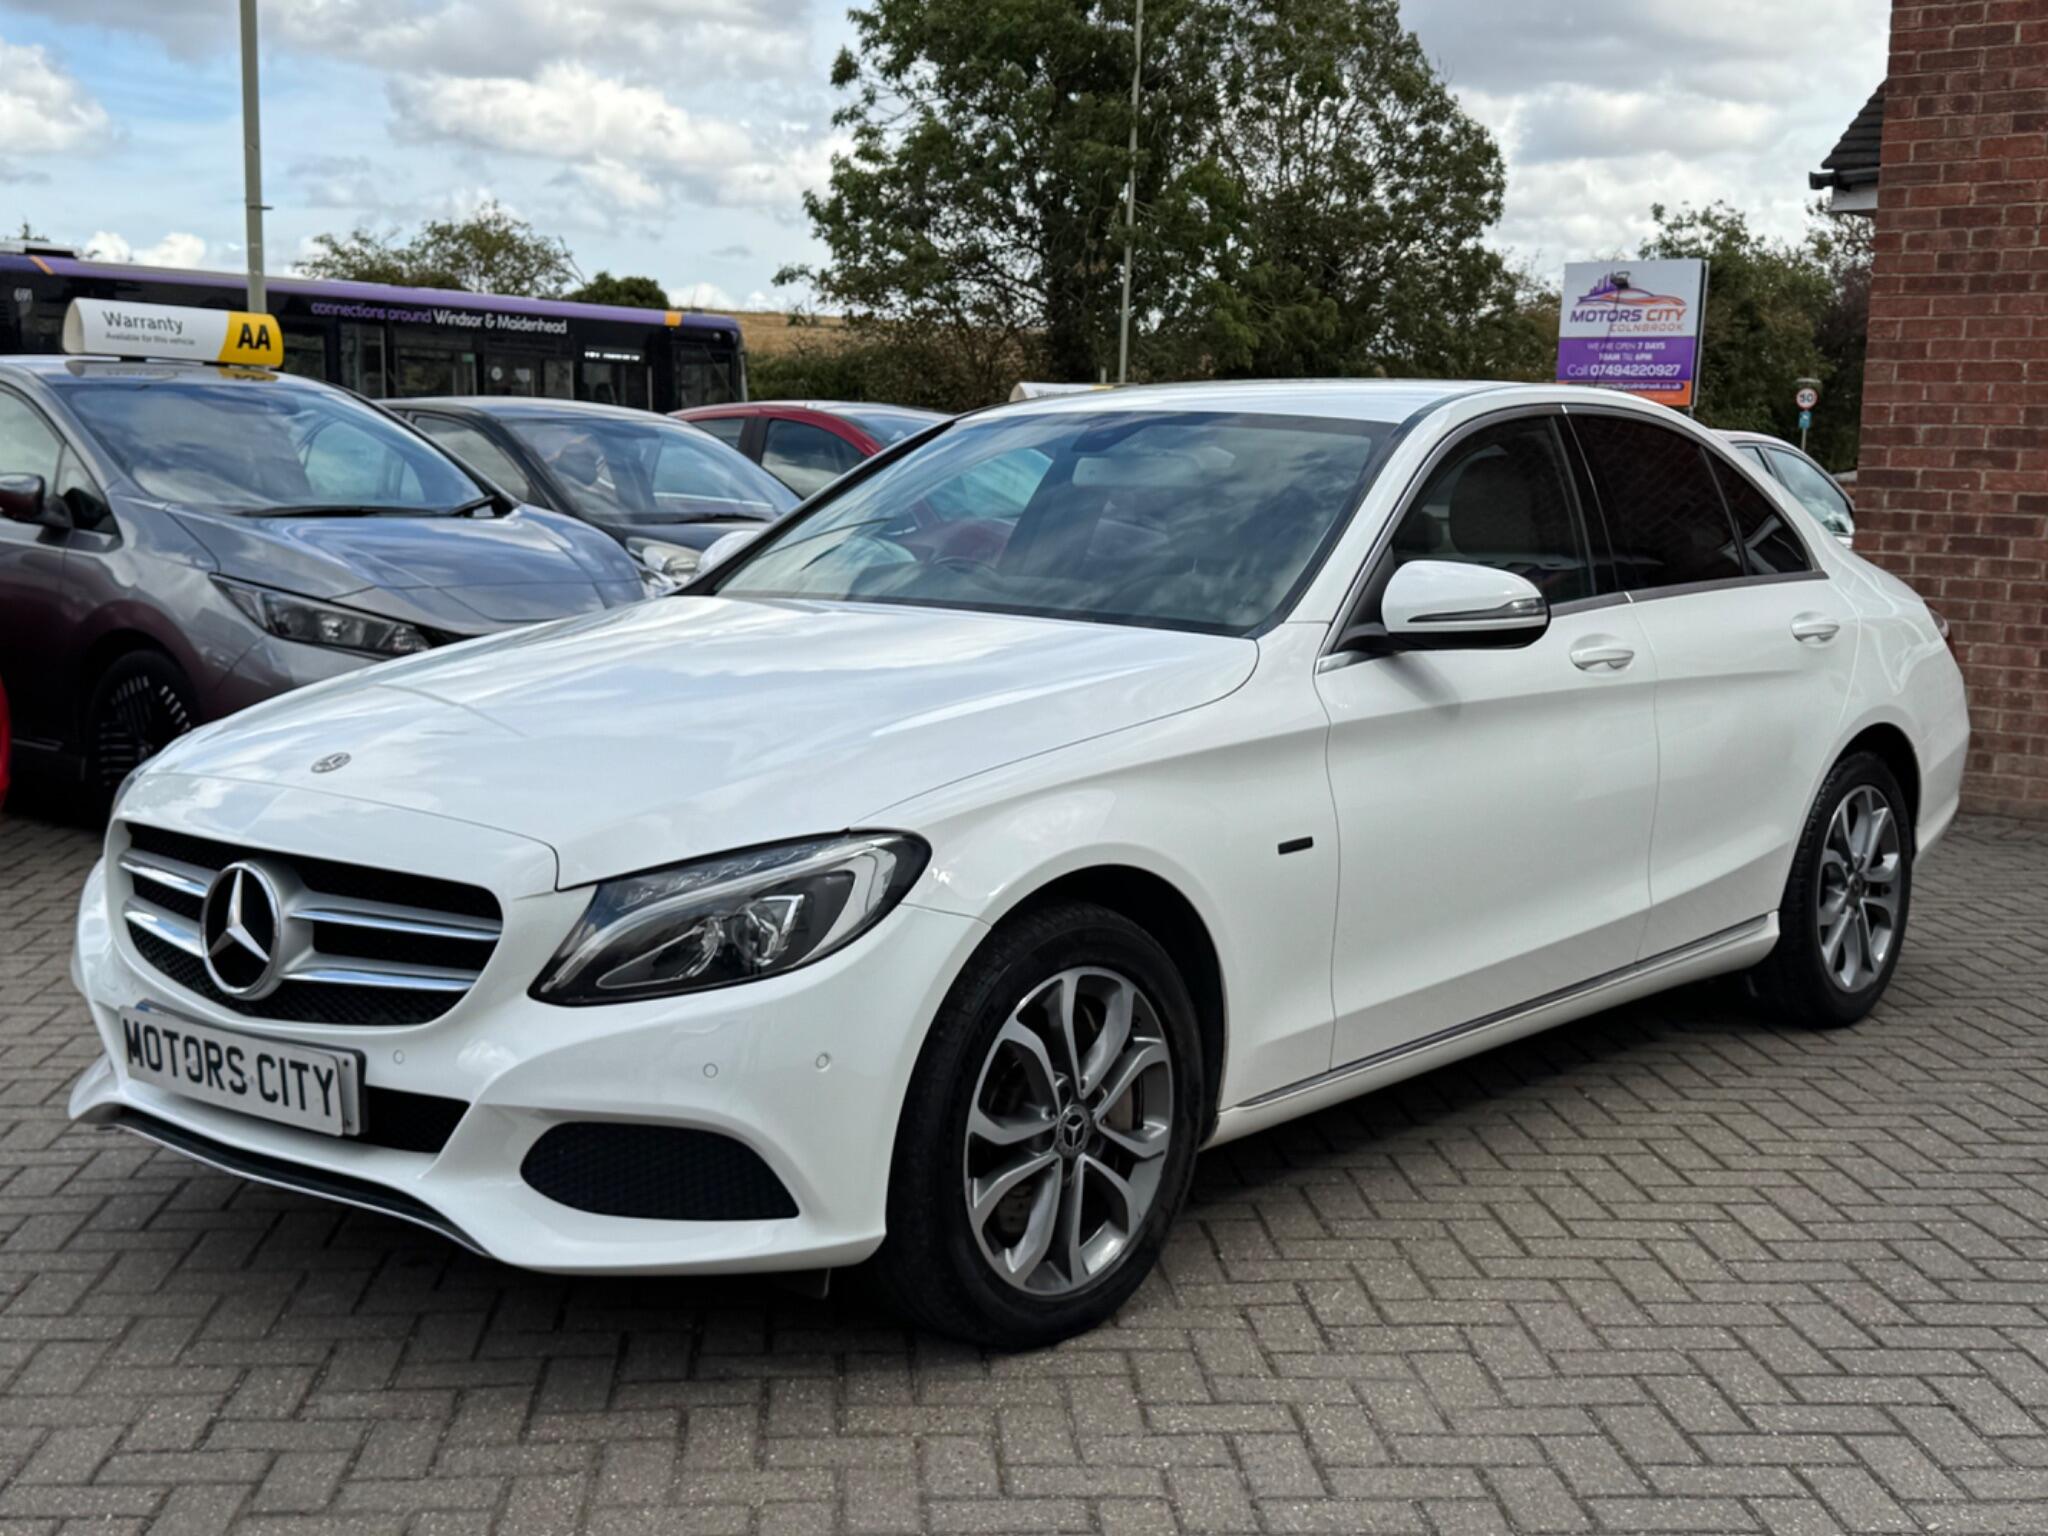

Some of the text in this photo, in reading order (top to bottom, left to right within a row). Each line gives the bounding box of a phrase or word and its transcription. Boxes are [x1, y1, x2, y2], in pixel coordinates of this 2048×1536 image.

[311, 302, 568, 334] connections around Windsor & Maidenhead
[1569, 308, 1686, 322] MOTORS CITY
[102, 311, 183, 335] Warranty
[1610, 323, 1684, 332] COLNBROOK
[105, 332, 195, 346] Available for this vehicle
[237, 323, 271, 351] AA
[1587, 342, 1598, 350] WE
[1615, 342, 1636, 350] OPEN
[1644, 342, 1666, 350] DAYS
[1567, 364, 1681, 376] Call 07494220927
[123, 1018, 334, 1117] MOTORS CITY
